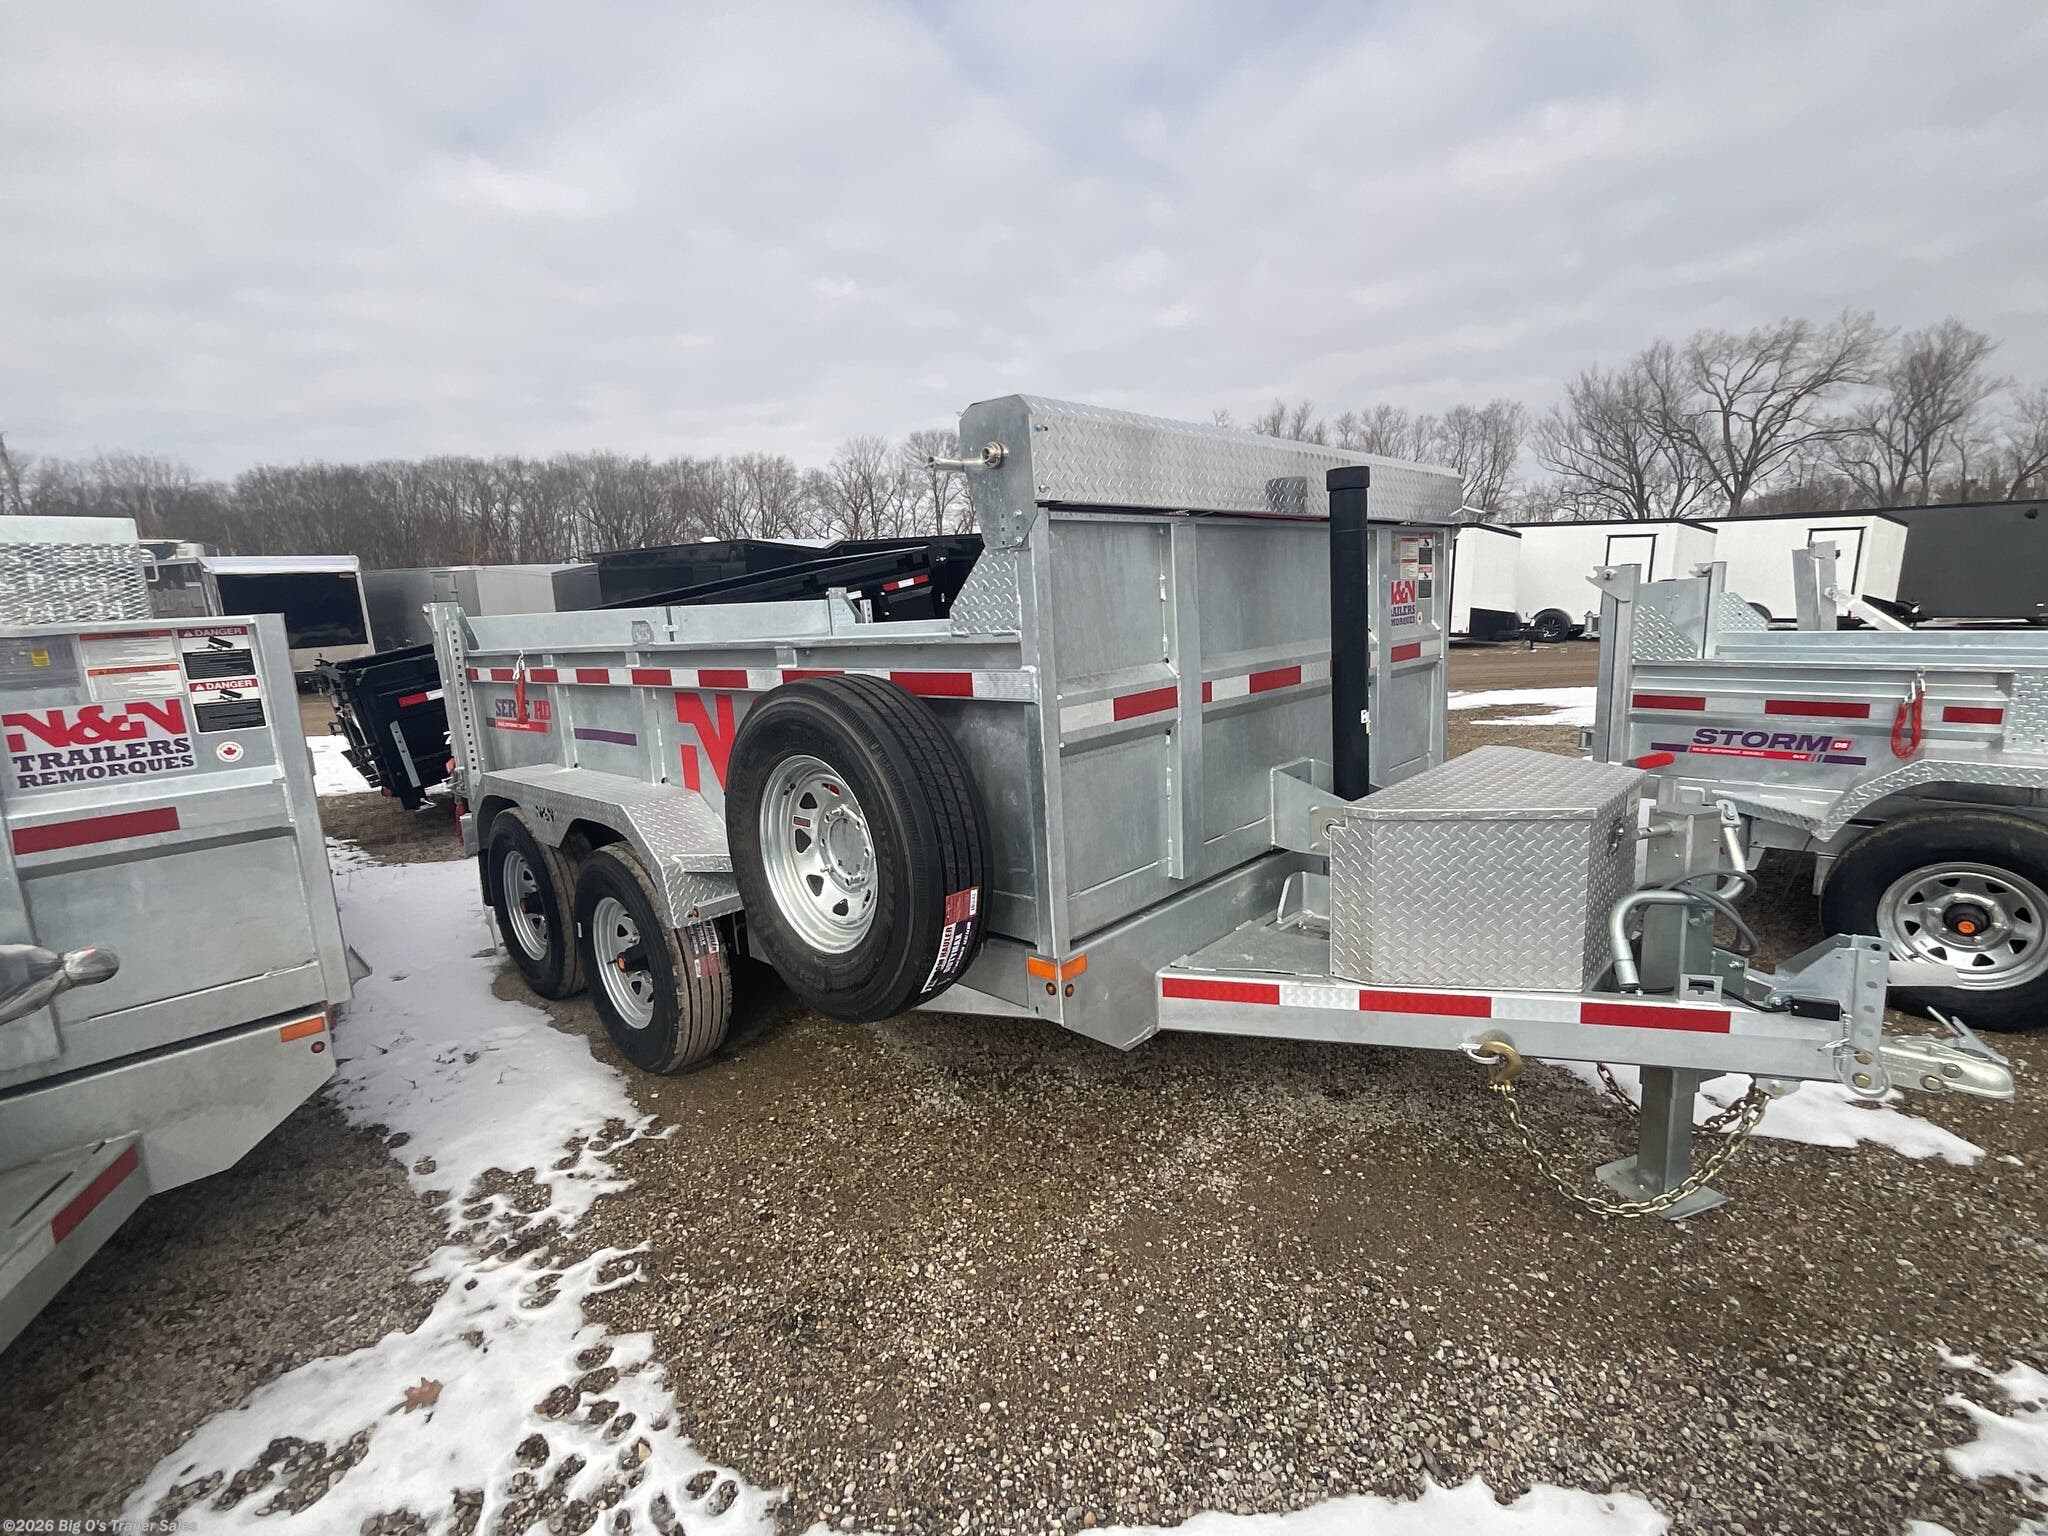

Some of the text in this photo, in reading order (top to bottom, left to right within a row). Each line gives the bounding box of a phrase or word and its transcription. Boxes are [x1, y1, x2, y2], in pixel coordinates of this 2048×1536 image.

[194, 627, 242, 636] DANGER
[205, 680, 253, 690] DANGER
[533, 700, 551, 720] HD
[1, 699, 187, 753] N&N
[1692, 728, 1833, 752] STORM
[12, 738, 192, 772] TRAILERS
[17, 755, 194, 789] REMORQUES
[941, 926, 953, 958] HAULER
